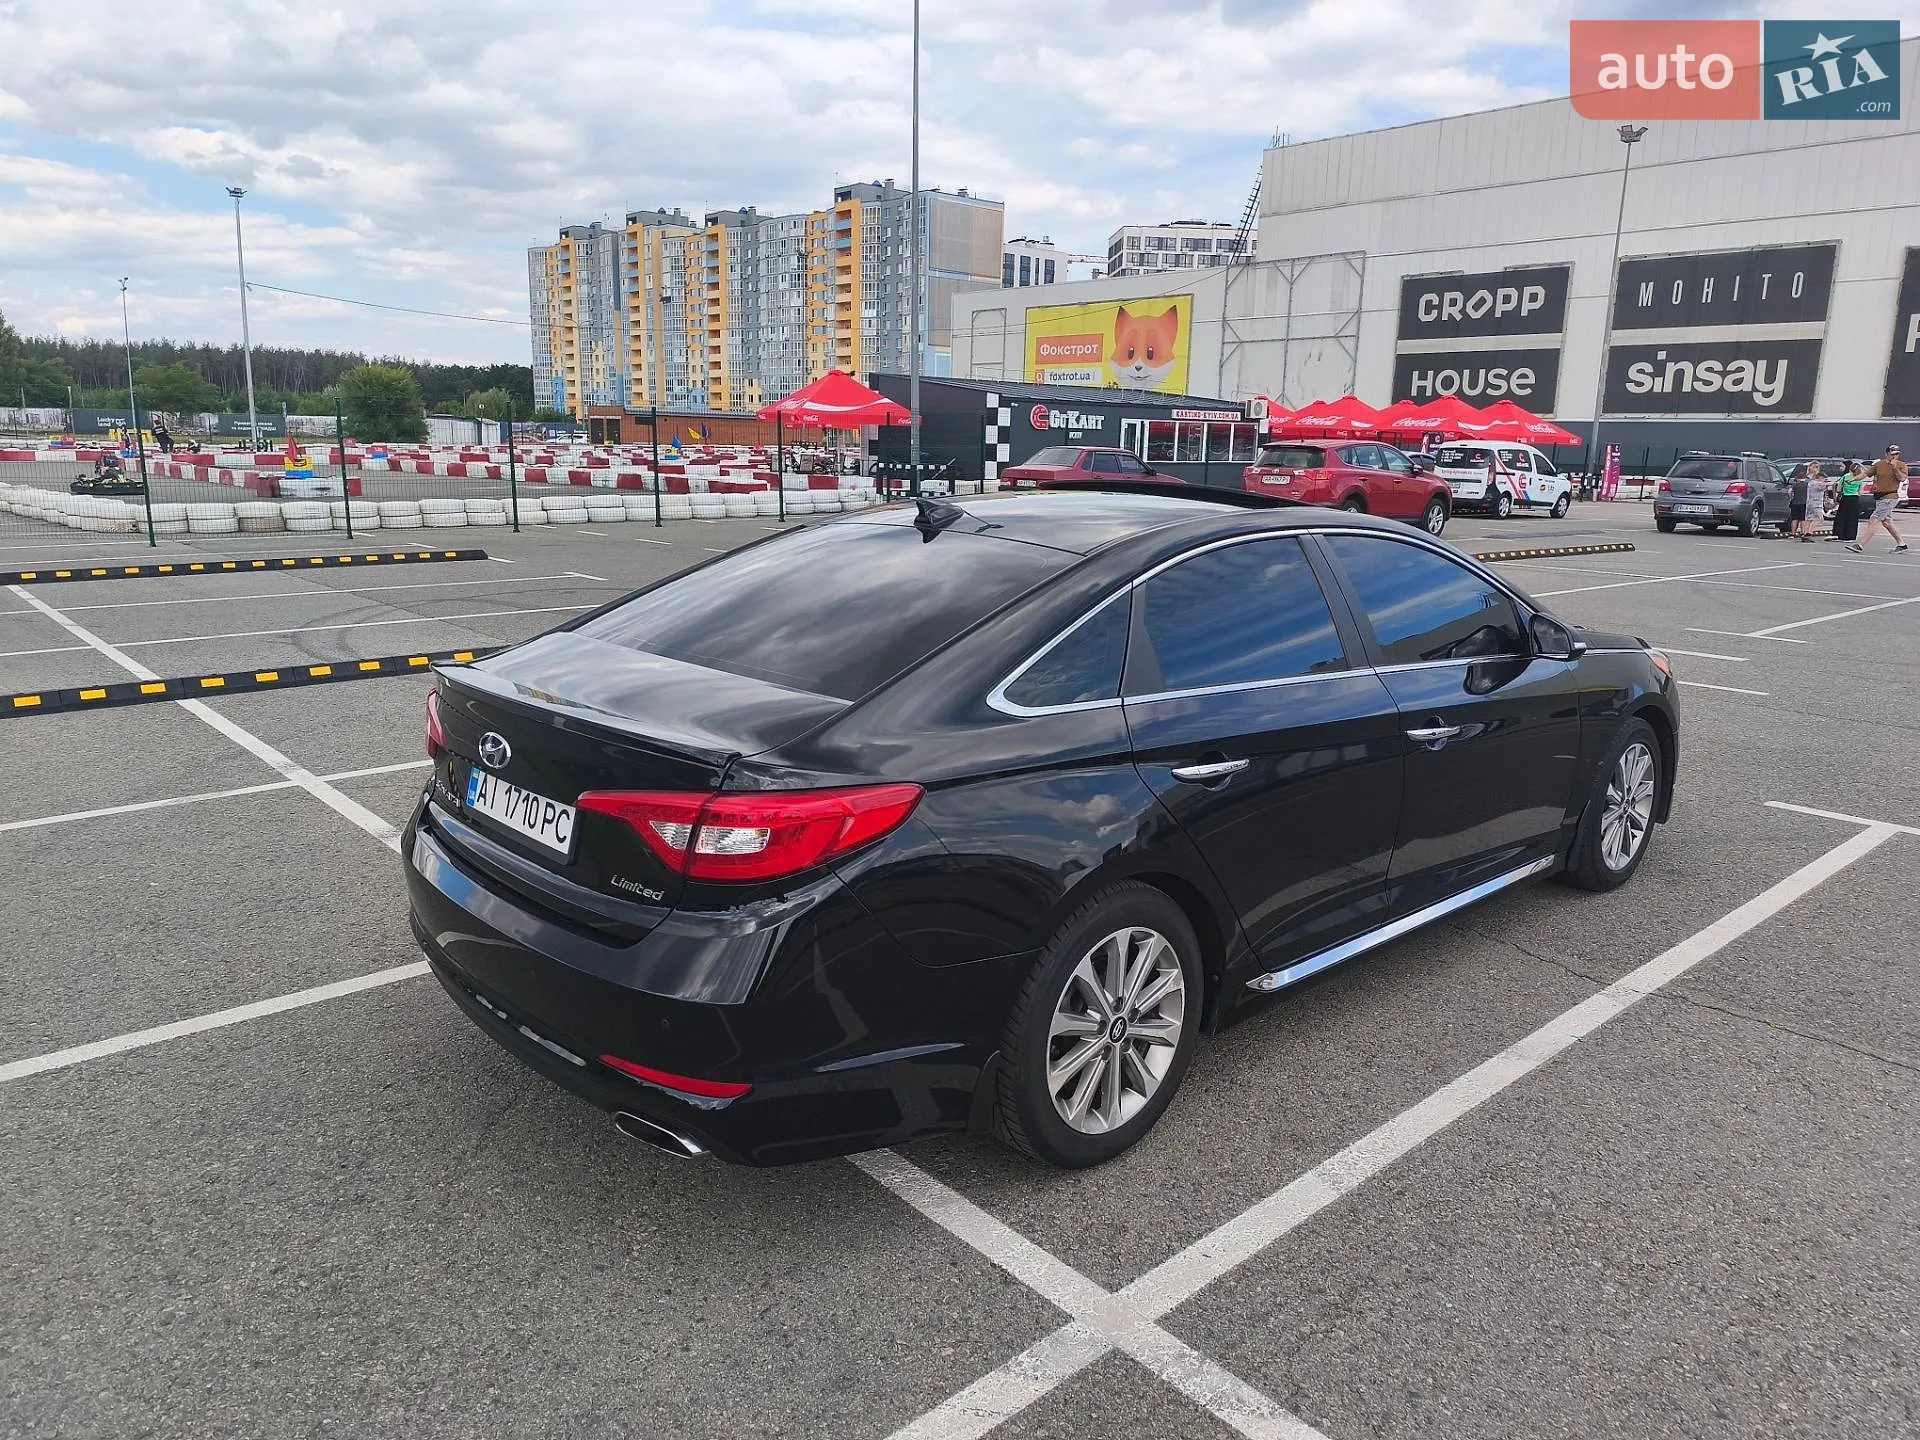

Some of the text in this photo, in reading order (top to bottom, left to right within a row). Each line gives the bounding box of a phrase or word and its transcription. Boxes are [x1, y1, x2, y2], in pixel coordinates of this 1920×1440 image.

[1417, 285, 1546, 322] CROPP
[1638, 271, 1805, 307] MOHITO
[1040, 343, 1099, 357] Фокстрот
[1049, 371, 1091, 381] foxtrot.ua
[1624, 350, 1789, 407] sinsay
[476, 773, 570, 844] AI 1710 PC
[610, 874, 665, 901] Limited
